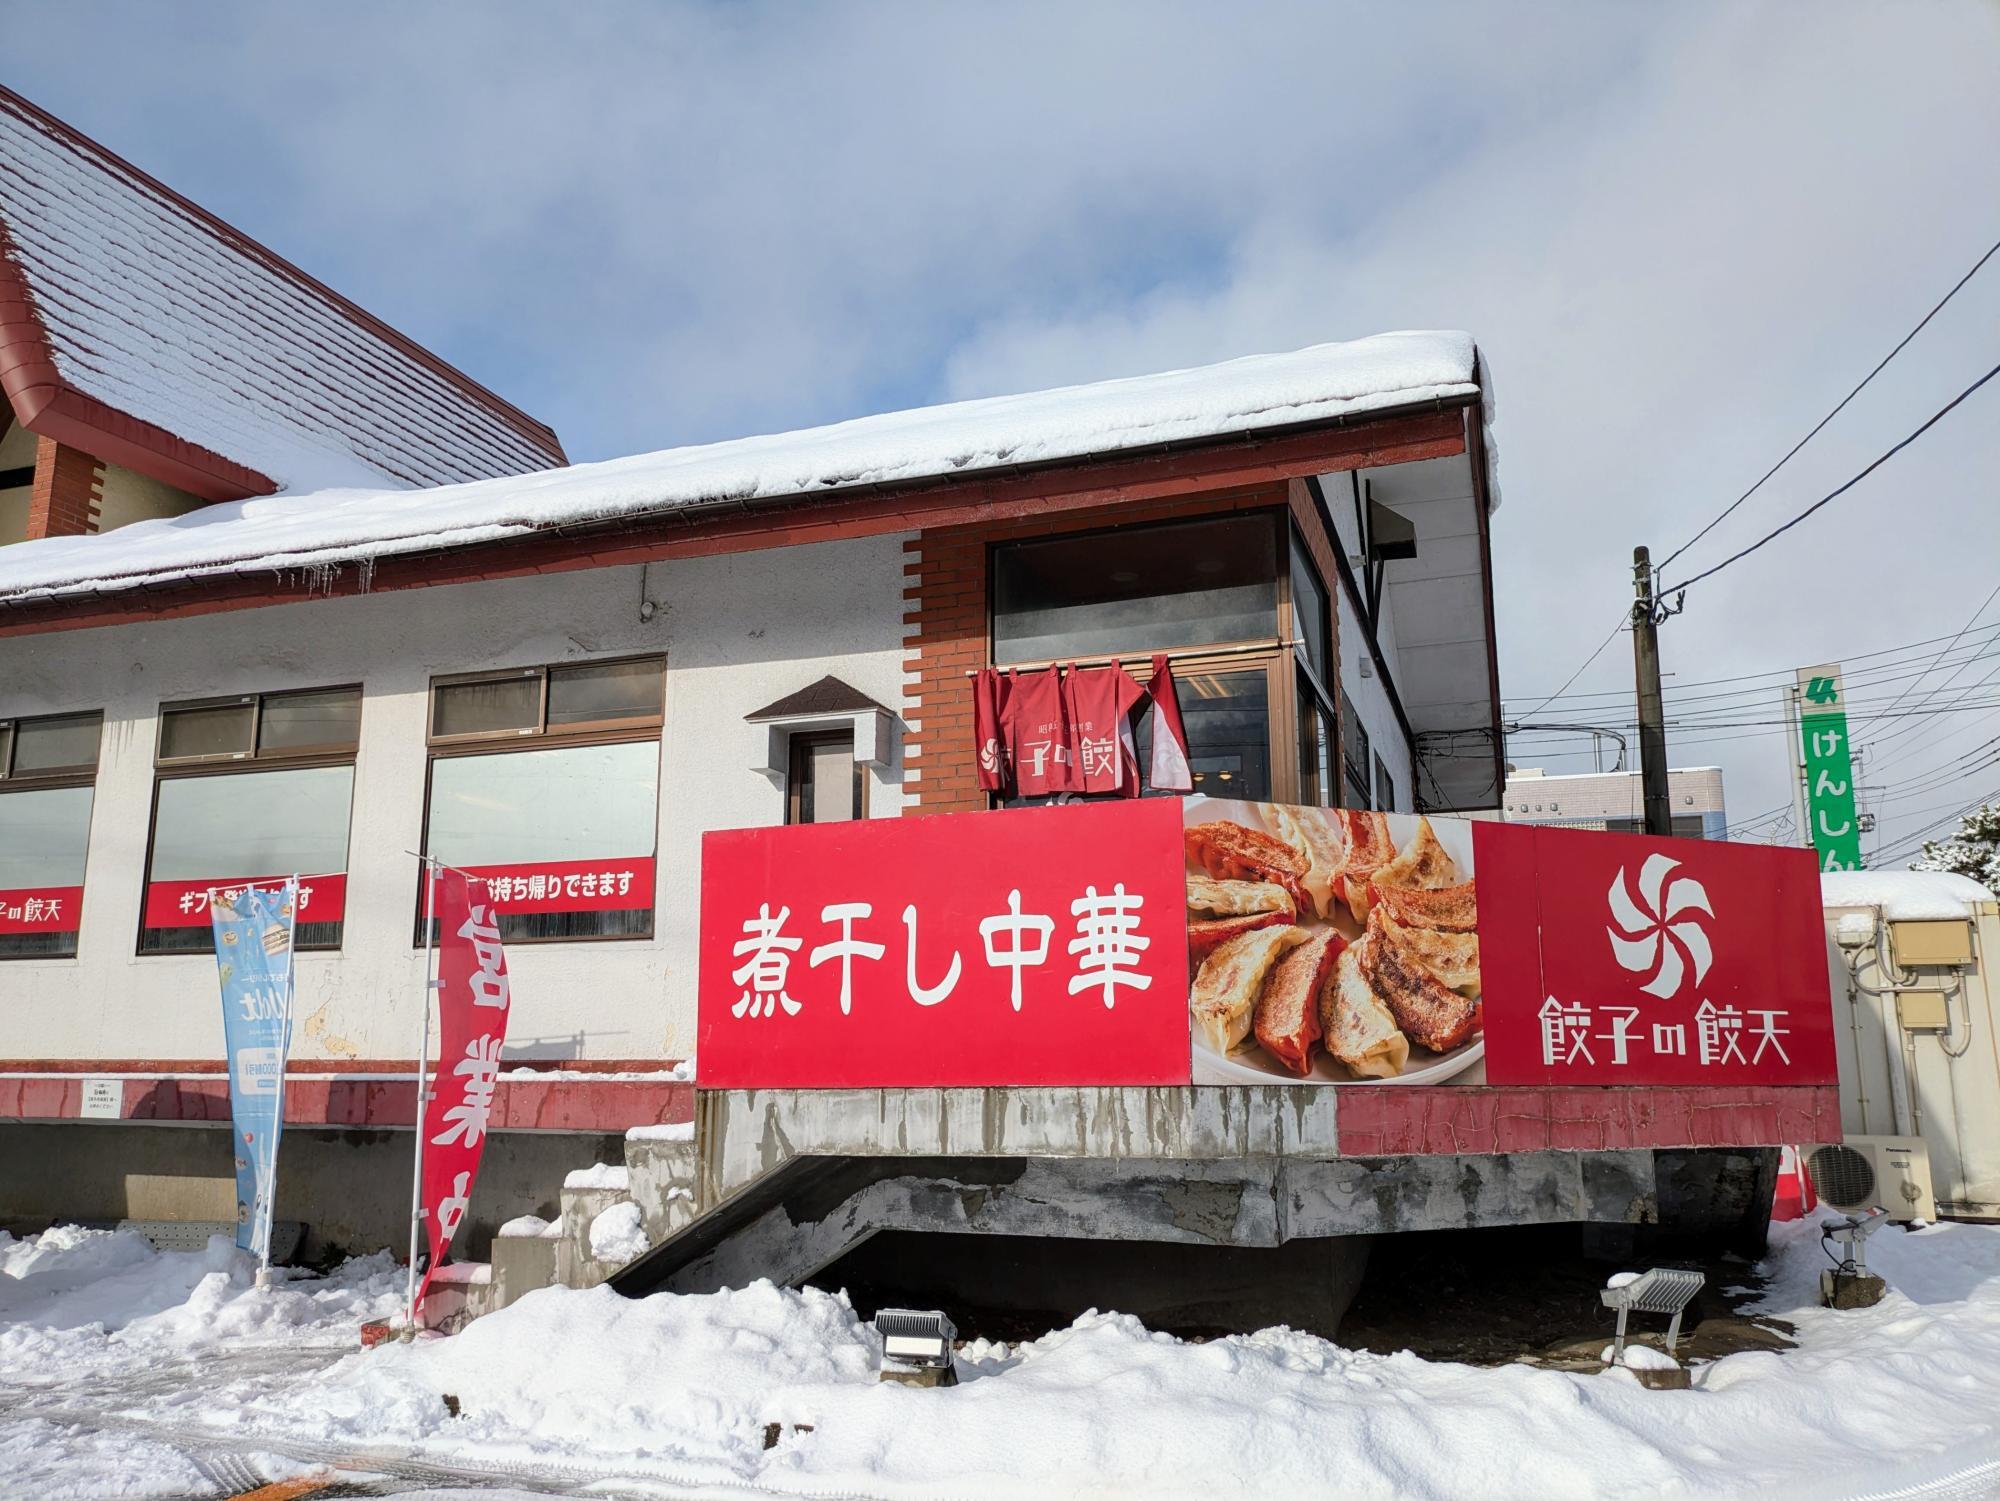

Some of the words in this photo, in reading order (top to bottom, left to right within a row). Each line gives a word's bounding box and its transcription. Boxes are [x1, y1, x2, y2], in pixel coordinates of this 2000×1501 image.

[731, 882, 1153, 1019] 煮干し中華
[1537, 993, 1791, 1067] 餃子の餃天
